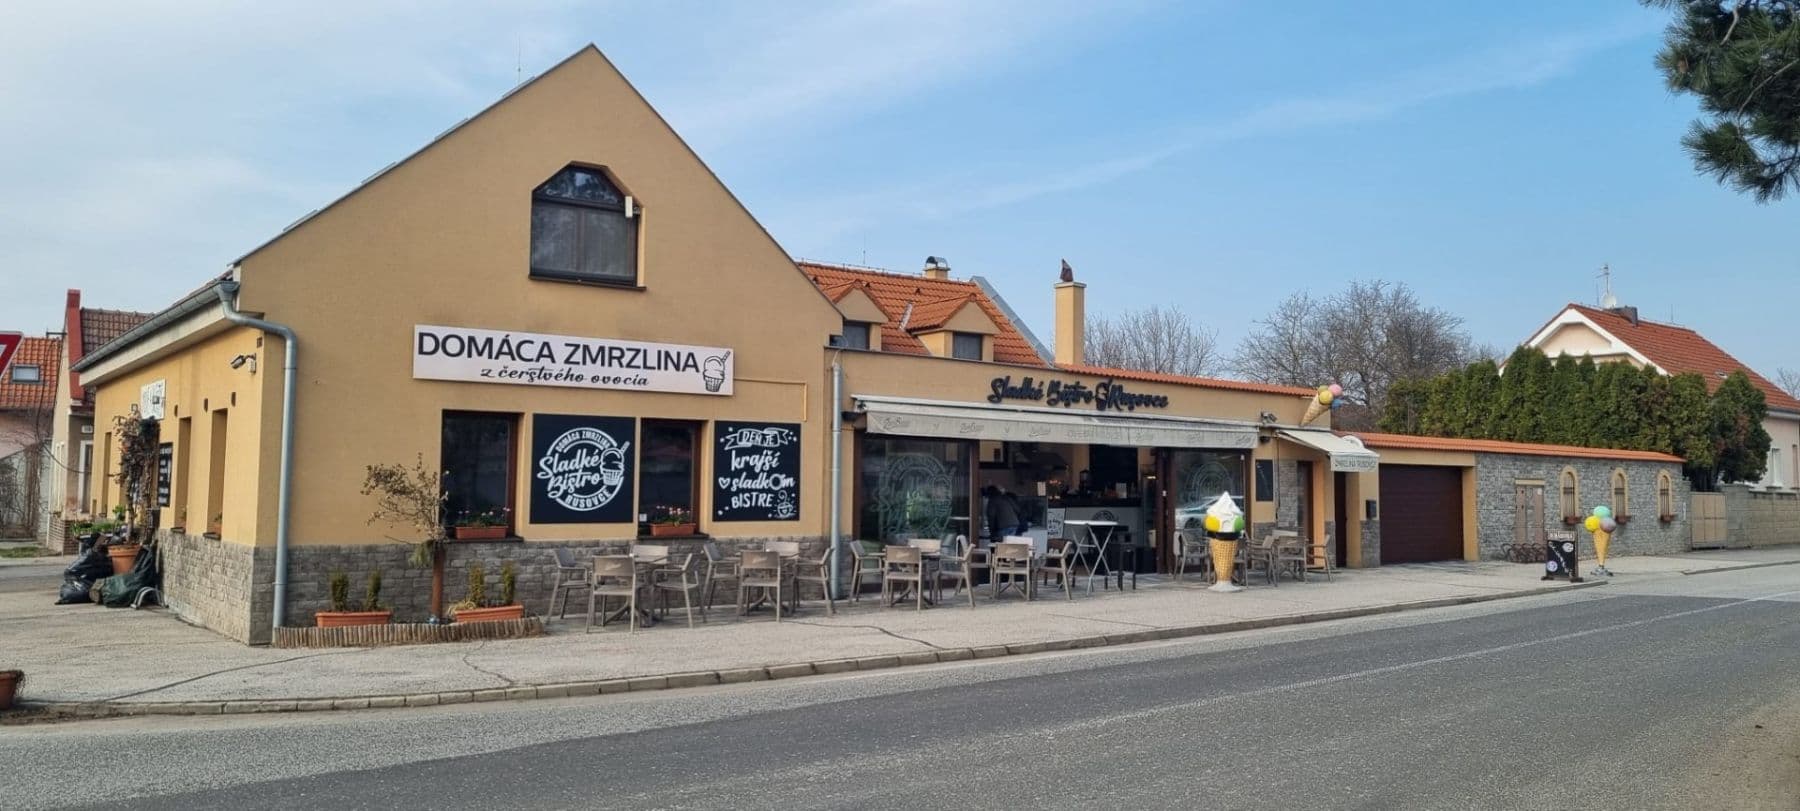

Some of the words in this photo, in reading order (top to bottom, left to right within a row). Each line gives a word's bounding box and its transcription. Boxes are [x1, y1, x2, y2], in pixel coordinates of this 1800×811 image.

[417, 332, 556, 364] DOMÁCA
[563, 343, 700, 373] ZMRZLINA
[498, 365, 584, 383] čerstvého
[591, 373, 649, 386] ovocia
[987, 376, 1044, 403] Sladké
[537, 448, 601, 479] Sladké
[731, 449, 781, 473] krajší
[547, 469, 604, 499] Bistro
[565, 489, 612, 509] RUSOVCE
[731, 491, 774, 509] BISTRE
